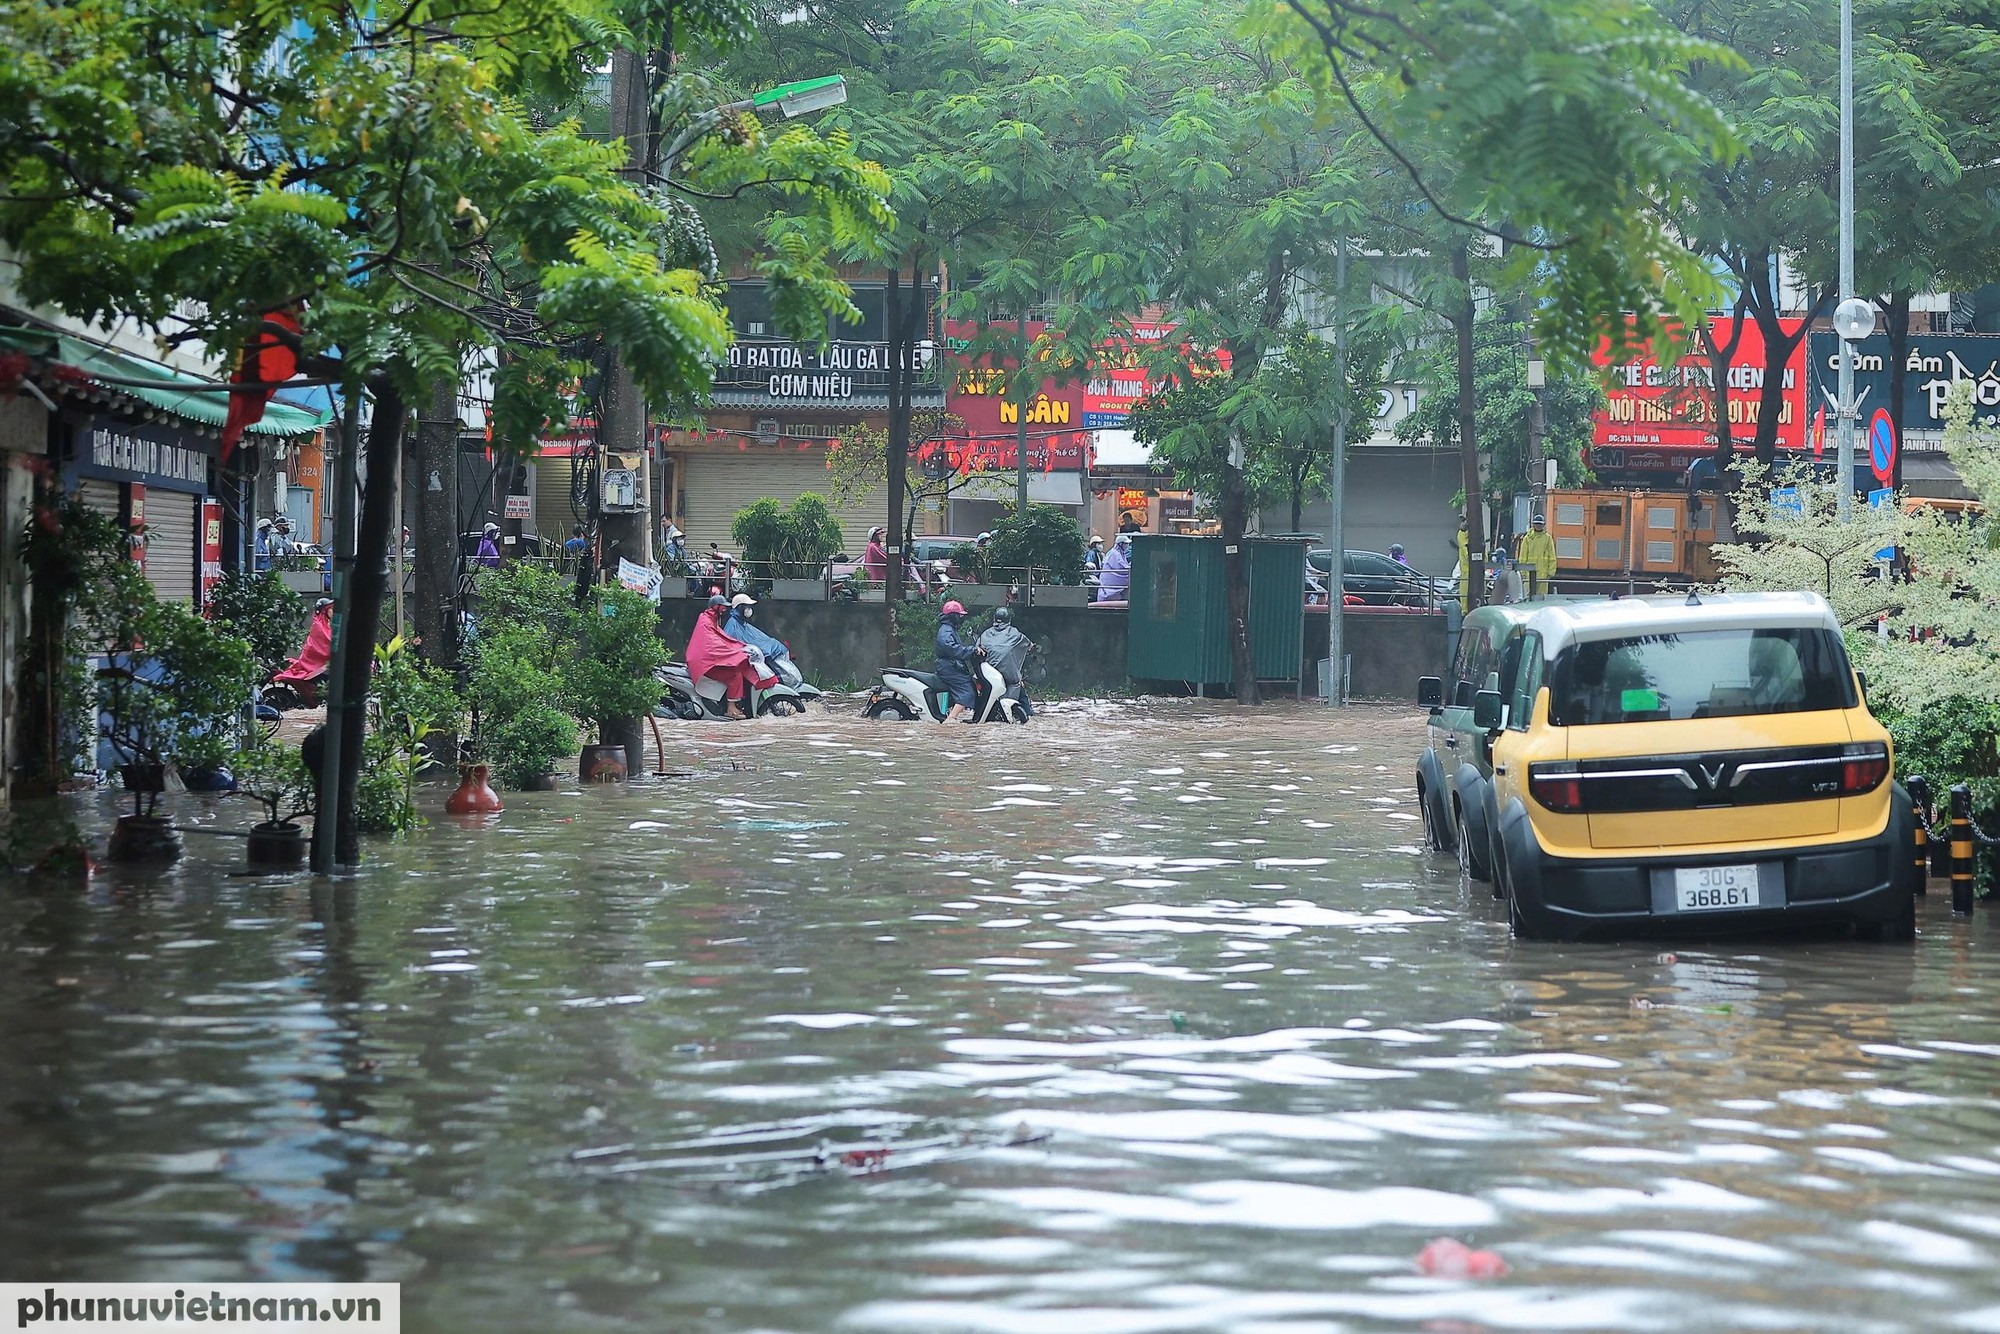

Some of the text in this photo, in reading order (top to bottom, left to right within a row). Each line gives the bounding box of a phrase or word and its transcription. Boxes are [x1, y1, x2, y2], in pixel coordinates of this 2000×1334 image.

[747, 347, 803, 370] BATOA
[856, 345, 879, 370] GÀ
[769, 372, 852, 398] CƠM NIÊU
[1110, 380, 1143, 397] THANG
[302, 466, 319, 477] 324
[1699, 868, 1735, 887] 30G
[1686, 887, 1749, 908] 368.61
